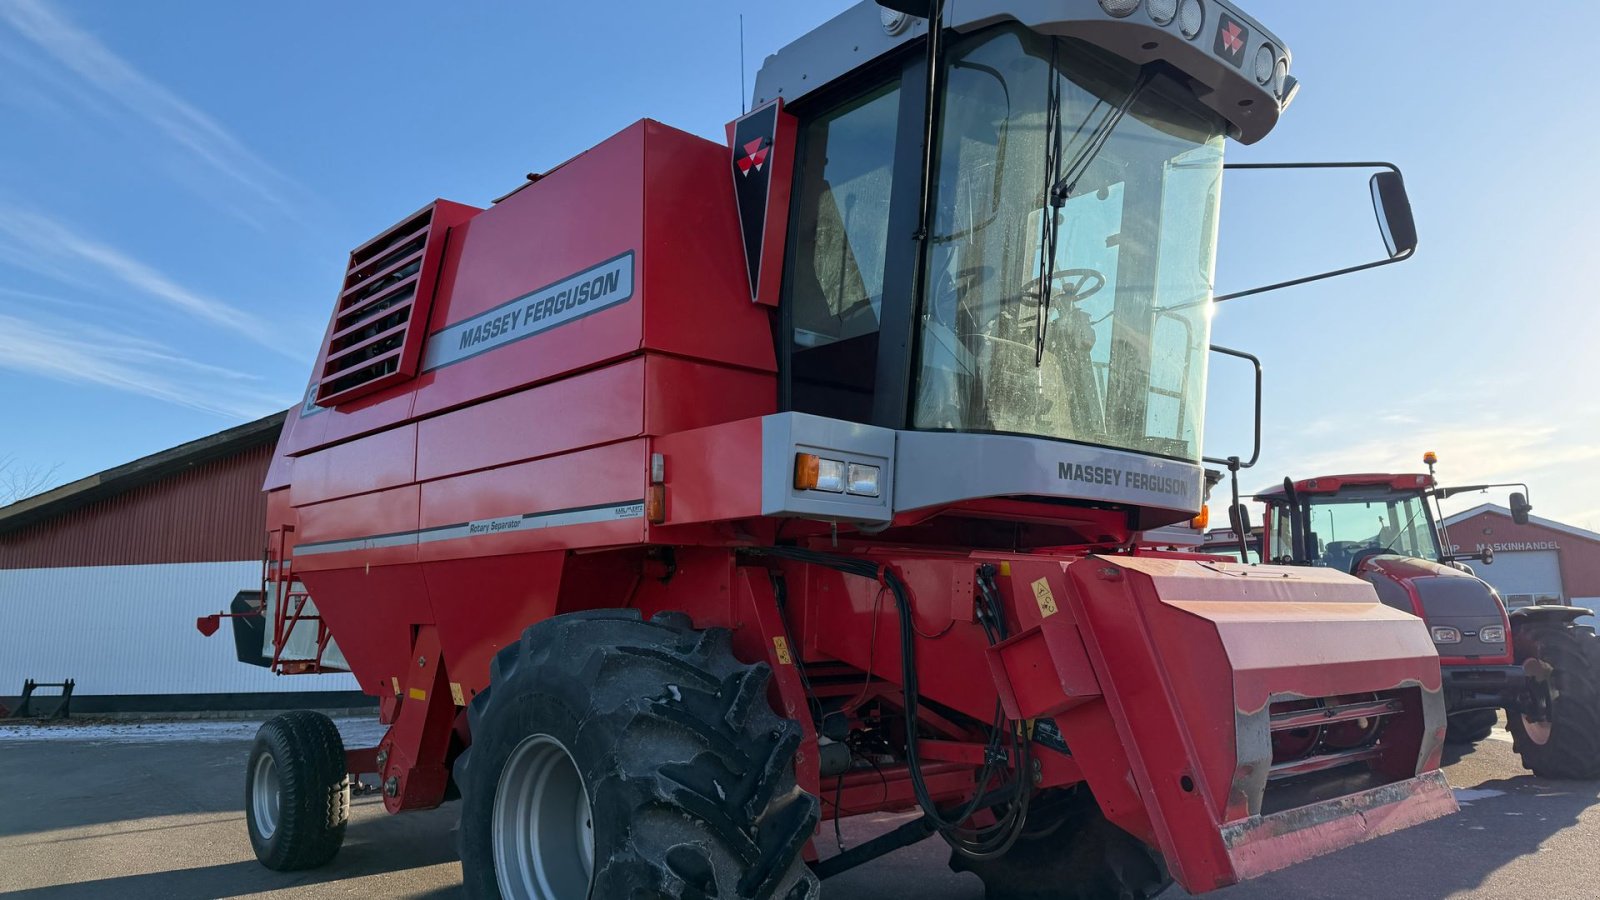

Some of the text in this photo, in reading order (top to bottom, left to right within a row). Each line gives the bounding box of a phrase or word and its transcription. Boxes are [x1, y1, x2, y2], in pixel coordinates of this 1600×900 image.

[458, 269, 621, 350] MASSEY FERGUSON
[1059, 462, 1187, 496] MASSEY FERGUSON
[469, 520, 521, 534] Rotary Separator
[1476, 541, 1561, 551] MASKINHANDEL
